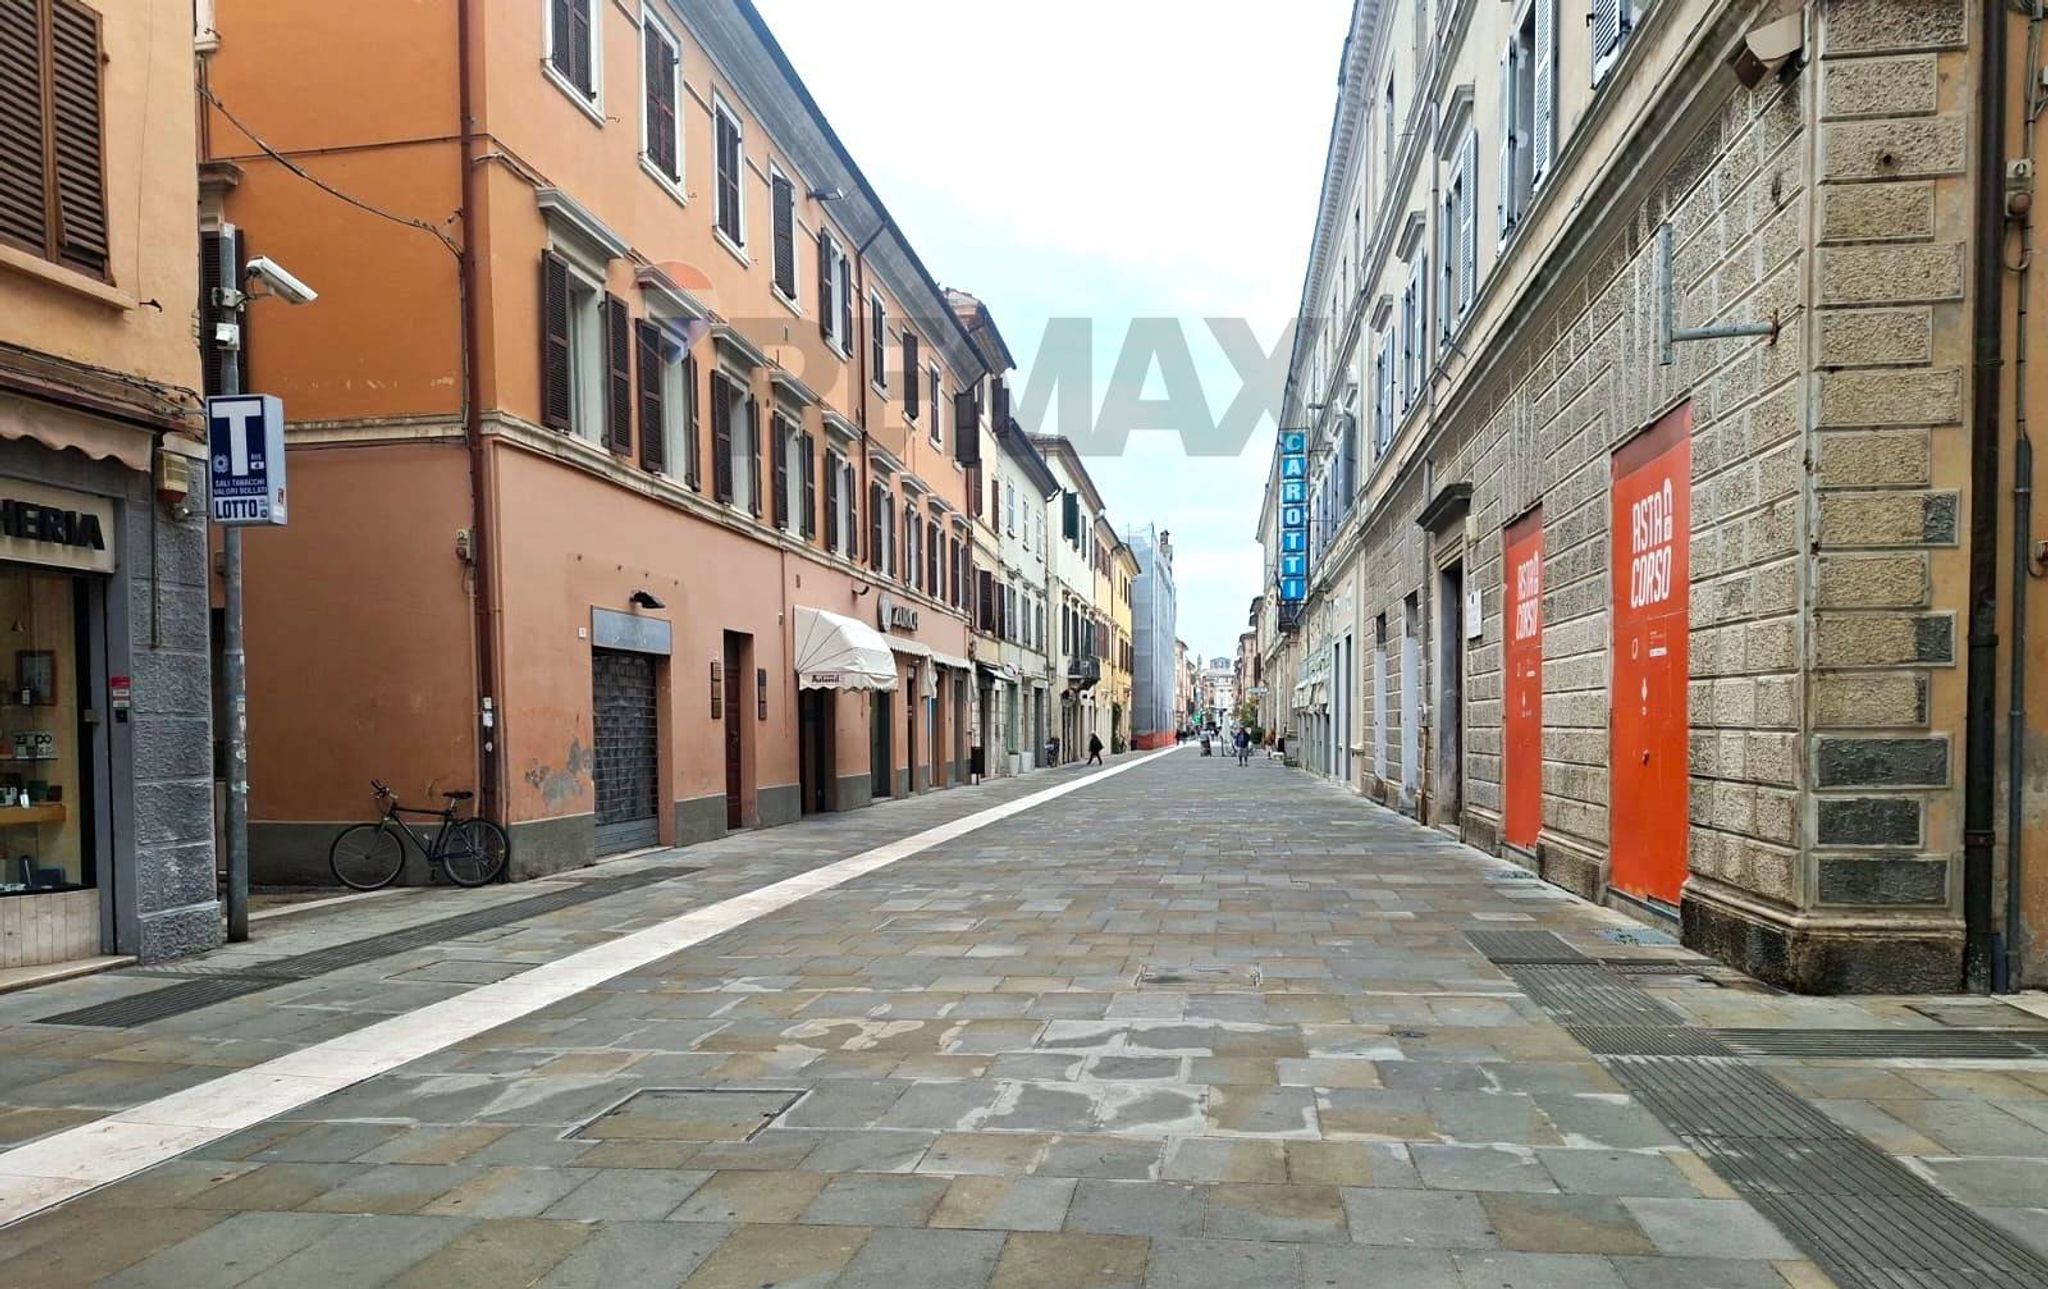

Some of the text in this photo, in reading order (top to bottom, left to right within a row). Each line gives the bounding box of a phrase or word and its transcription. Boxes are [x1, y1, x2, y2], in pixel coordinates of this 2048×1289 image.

[211, 401, 261, 476] T
[213, 486, 268, 495] VALORI BOLLATI
[232, 478, 265, 487] TABACCHI
[215, 499, 258, 519] LOTTO
[1286, 434, 1301, 598] CAROTTI
[1632, 491, 1663, 554] ASTA
[1517, 559, 1534, 599] ASTA
[1631, 545, 1672, 609] CORSO
[1516, 597, 1538, 640] CORSO
